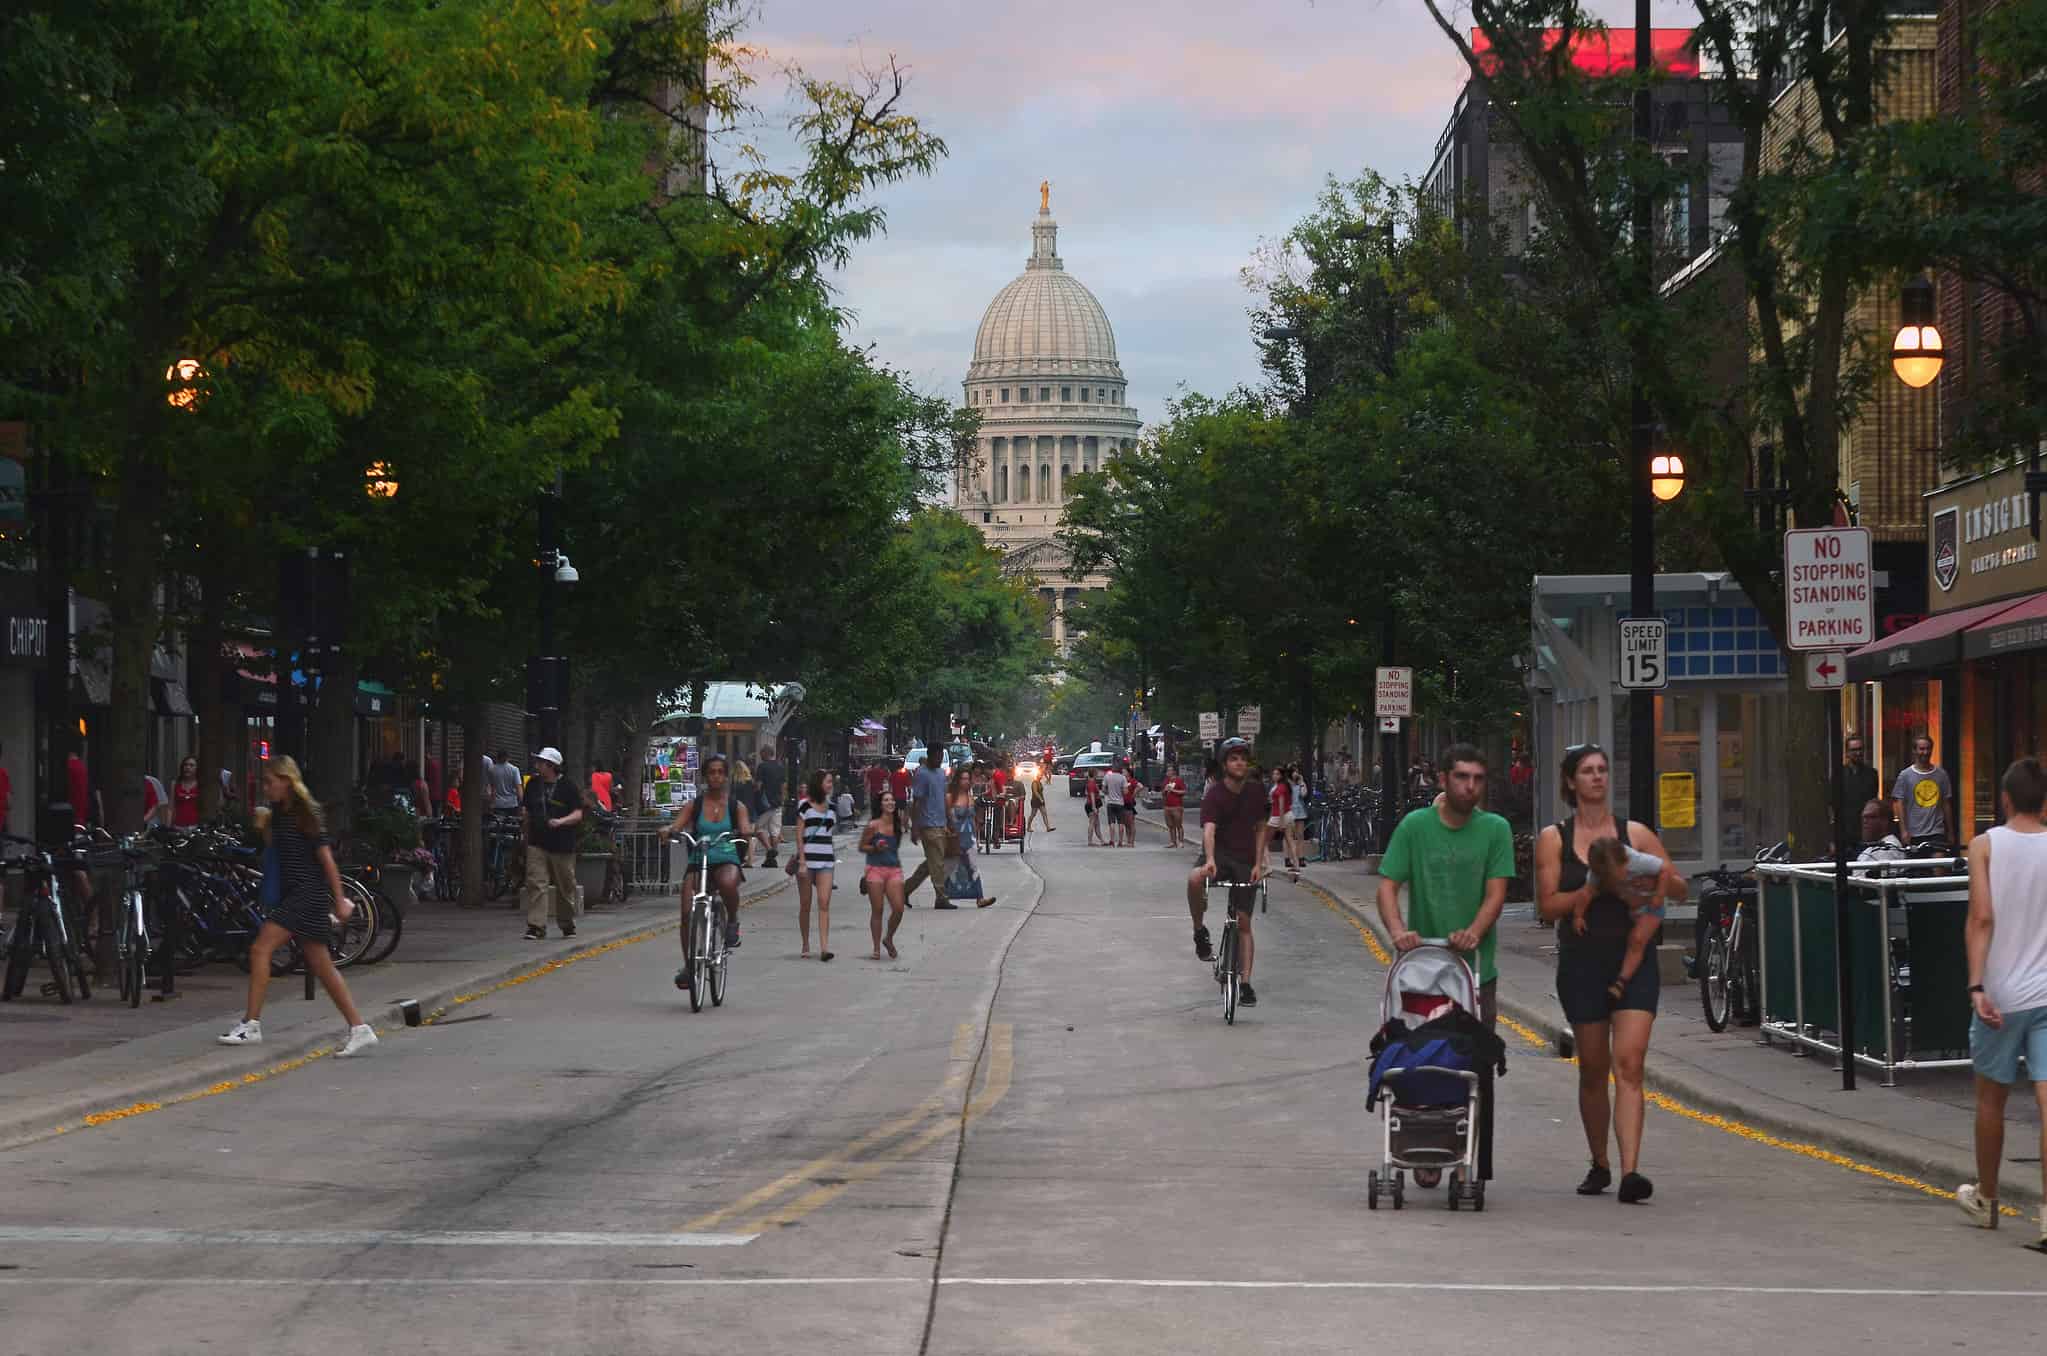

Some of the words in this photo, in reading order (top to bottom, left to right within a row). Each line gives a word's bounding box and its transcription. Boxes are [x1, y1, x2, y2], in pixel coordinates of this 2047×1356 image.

[1965, 492, 2032, 544] INSIGNI
[1814, 536, 1841, 559] NO
[1792, 563, 1865, 582] STOPPING
[1792, 584, 1866, 604] STANDING
[10, 616, 48, 656] CHIPOT
[1623, 625, 1663, 638] SPEED
[1798, 618, 1863, 637] PARKING
[1627, 639, 1657, 651] LIMIT
[1388, 670, 1400, 680] NO
[1627, 654, 1659, 682] 15
[1378, 690, 1409, 698] STANDING
[1379, 703, 1408, 712] PARKING
